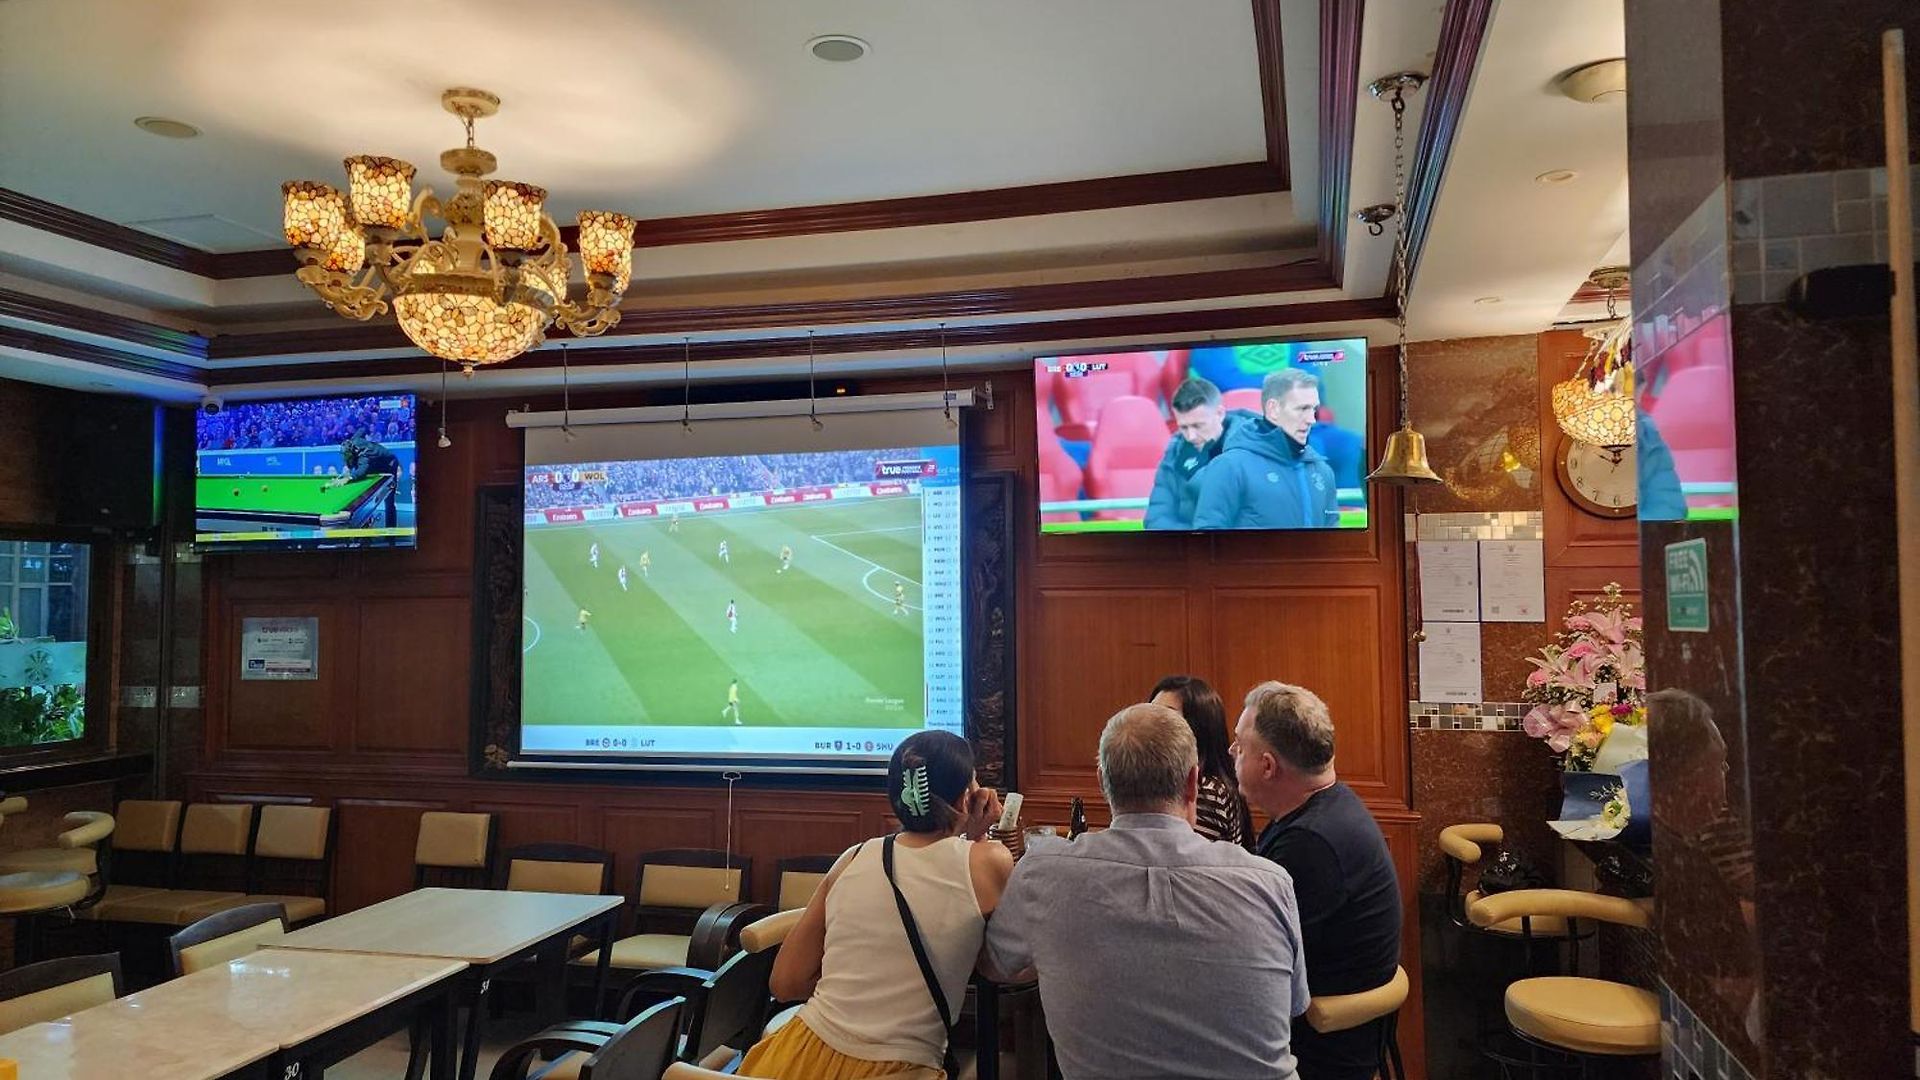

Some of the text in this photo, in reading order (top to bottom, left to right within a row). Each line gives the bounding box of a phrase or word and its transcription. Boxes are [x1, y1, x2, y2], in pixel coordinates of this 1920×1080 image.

[532, 474, 549, 484] ARS
[583, 472, 605, 481] WOL
[640, 739, 656, 747] LUT
[814, 741, 832, 750] BUR
[846, 741, 861, 750] 1-0
[284, 1062, 300, 1080] 30
